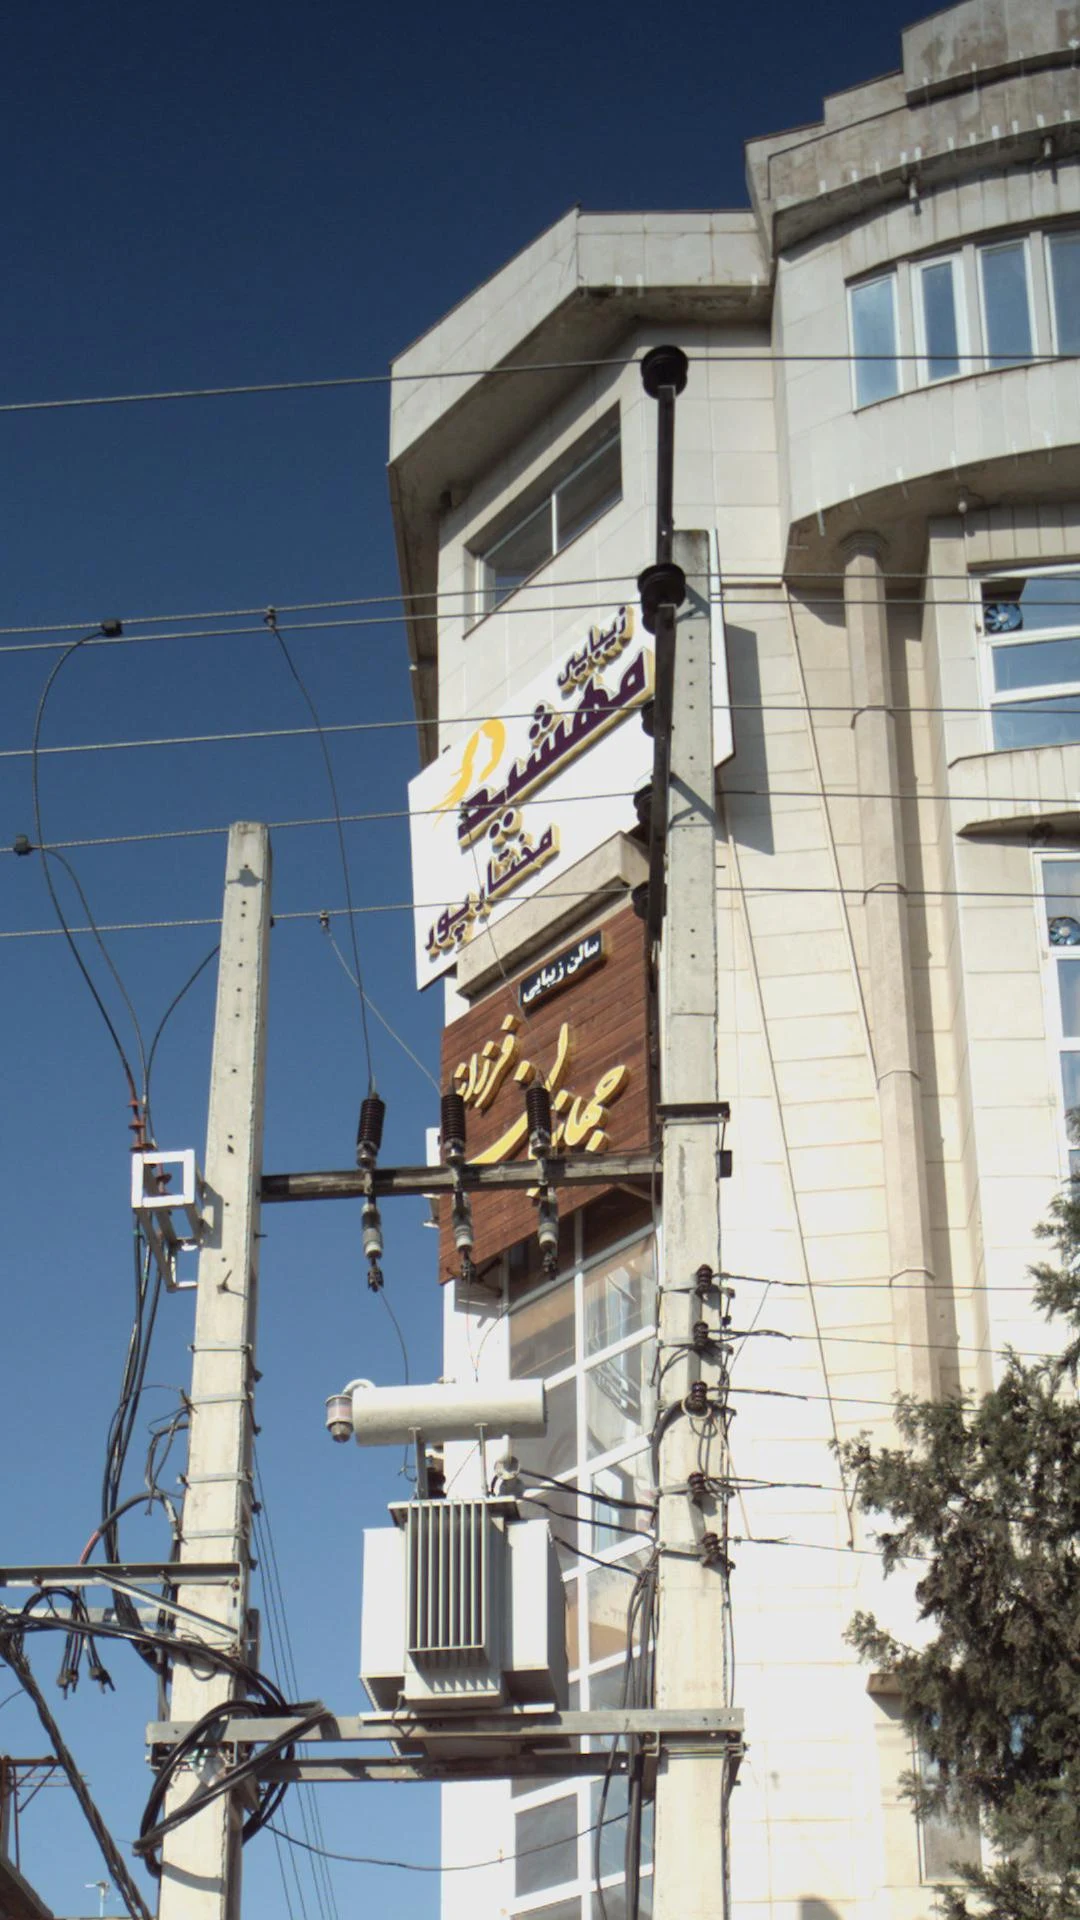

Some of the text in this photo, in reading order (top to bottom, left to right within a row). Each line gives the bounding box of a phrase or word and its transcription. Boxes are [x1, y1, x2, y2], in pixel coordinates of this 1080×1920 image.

[458, 650, 650, 842] مهشید
[522, 939, 600, 1003] سالن زیبایی
